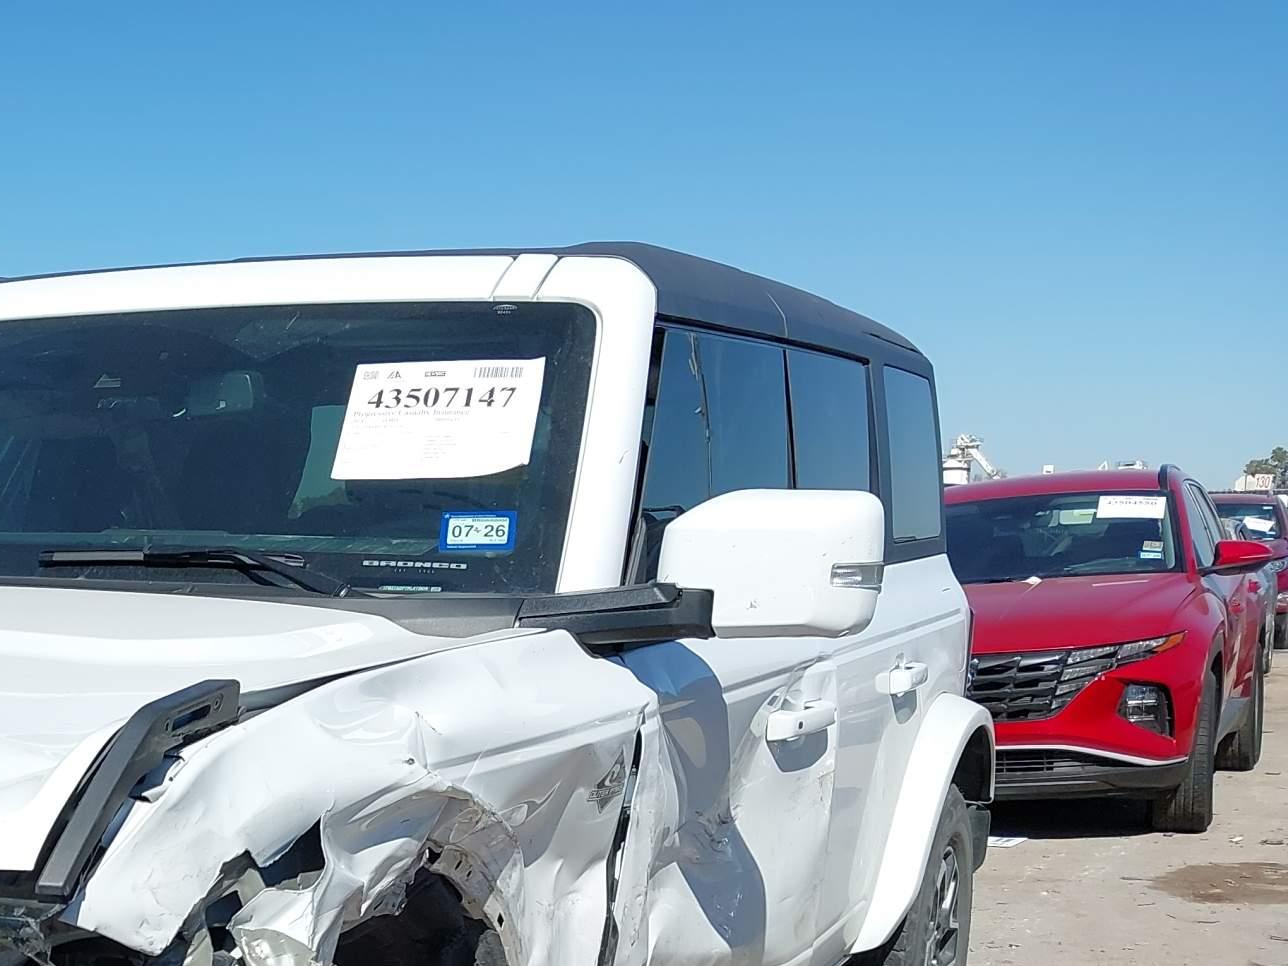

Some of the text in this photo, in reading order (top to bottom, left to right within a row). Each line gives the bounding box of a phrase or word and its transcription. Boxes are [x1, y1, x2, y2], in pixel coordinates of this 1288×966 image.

[368, 387, 517, 408] 43507147
[451, 524, 506, 538] 07 26
